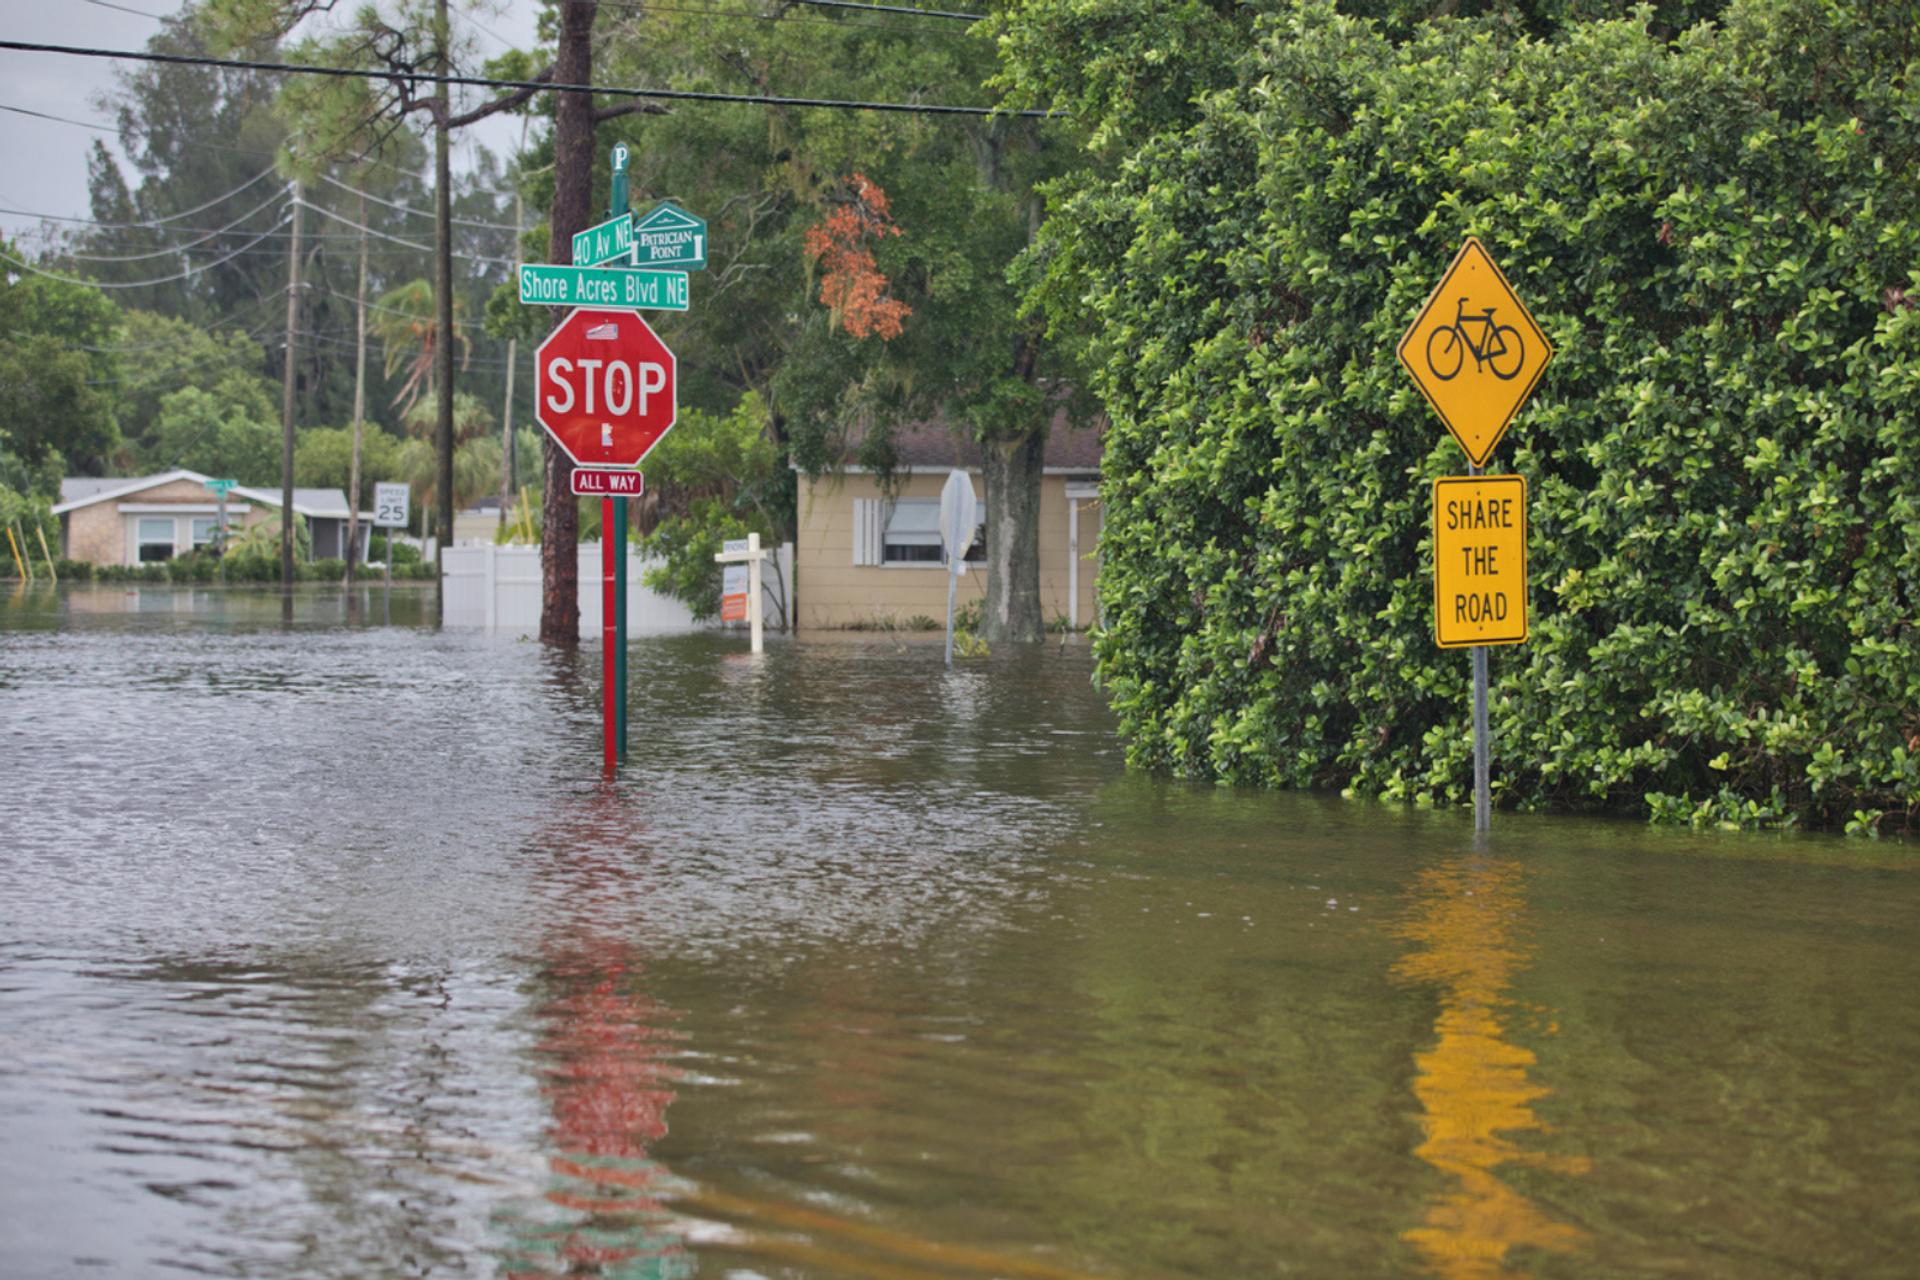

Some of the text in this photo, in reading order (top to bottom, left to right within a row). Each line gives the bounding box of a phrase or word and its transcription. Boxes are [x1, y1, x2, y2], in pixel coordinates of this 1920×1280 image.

[614, 147, 627, 169] P
[573, 219, 632, 264] 40 Av NE
[640, 230, 693, 247] PATRICIAN
[650, 245, 683, 260] POINT
[523, 270, 687, 305] Shore Acres Blvd NE
[547, 357, 666, 416] STOP
[579, 474, 637, 491] ALL WAY
[378, 504, 404, 521] 25
[1447, 499, 1512, 529] SHARE
[1462, 546, 1499, 576] THE
[1455, 592, 1507, 623] ROAD
